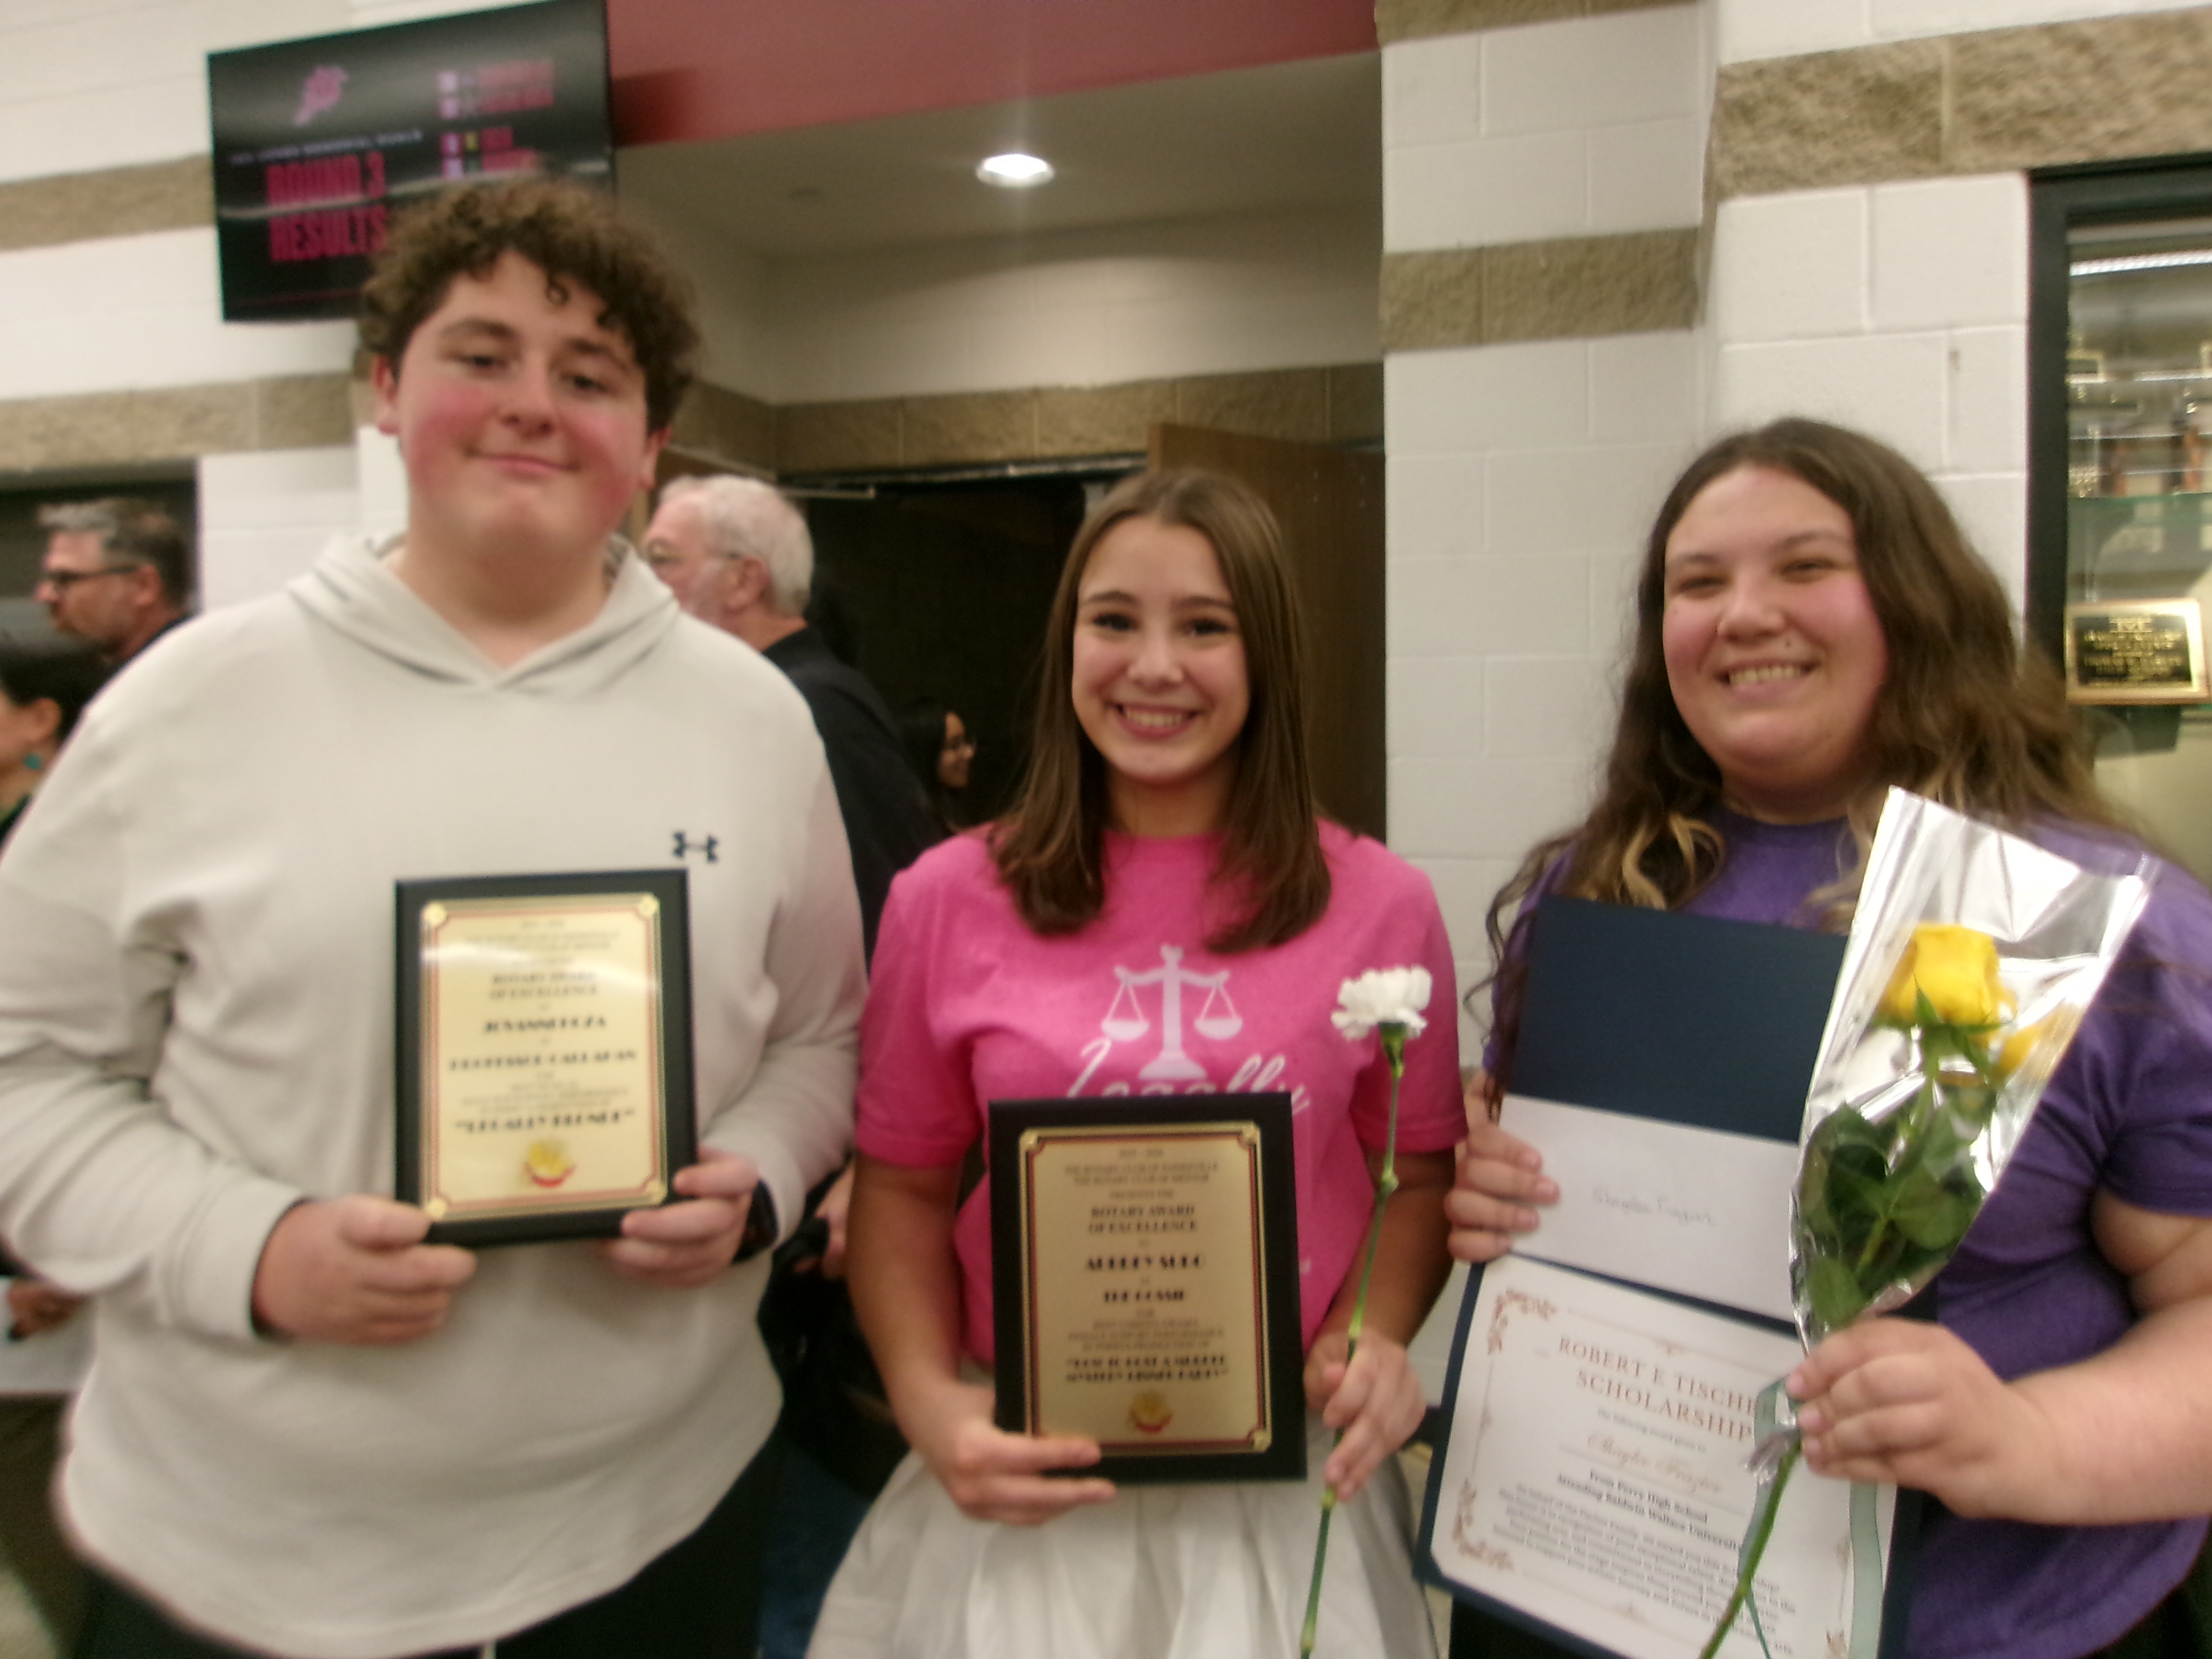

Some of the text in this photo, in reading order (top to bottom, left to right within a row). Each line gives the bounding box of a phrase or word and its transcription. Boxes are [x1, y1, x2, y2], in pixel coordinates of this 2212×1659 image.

[1558, 1336, 1646, 1377] ROBERT
[1652, 1366, 1665, 1387] E
[1576, 1369, 1754, 1442] SCHOLARSHIP
